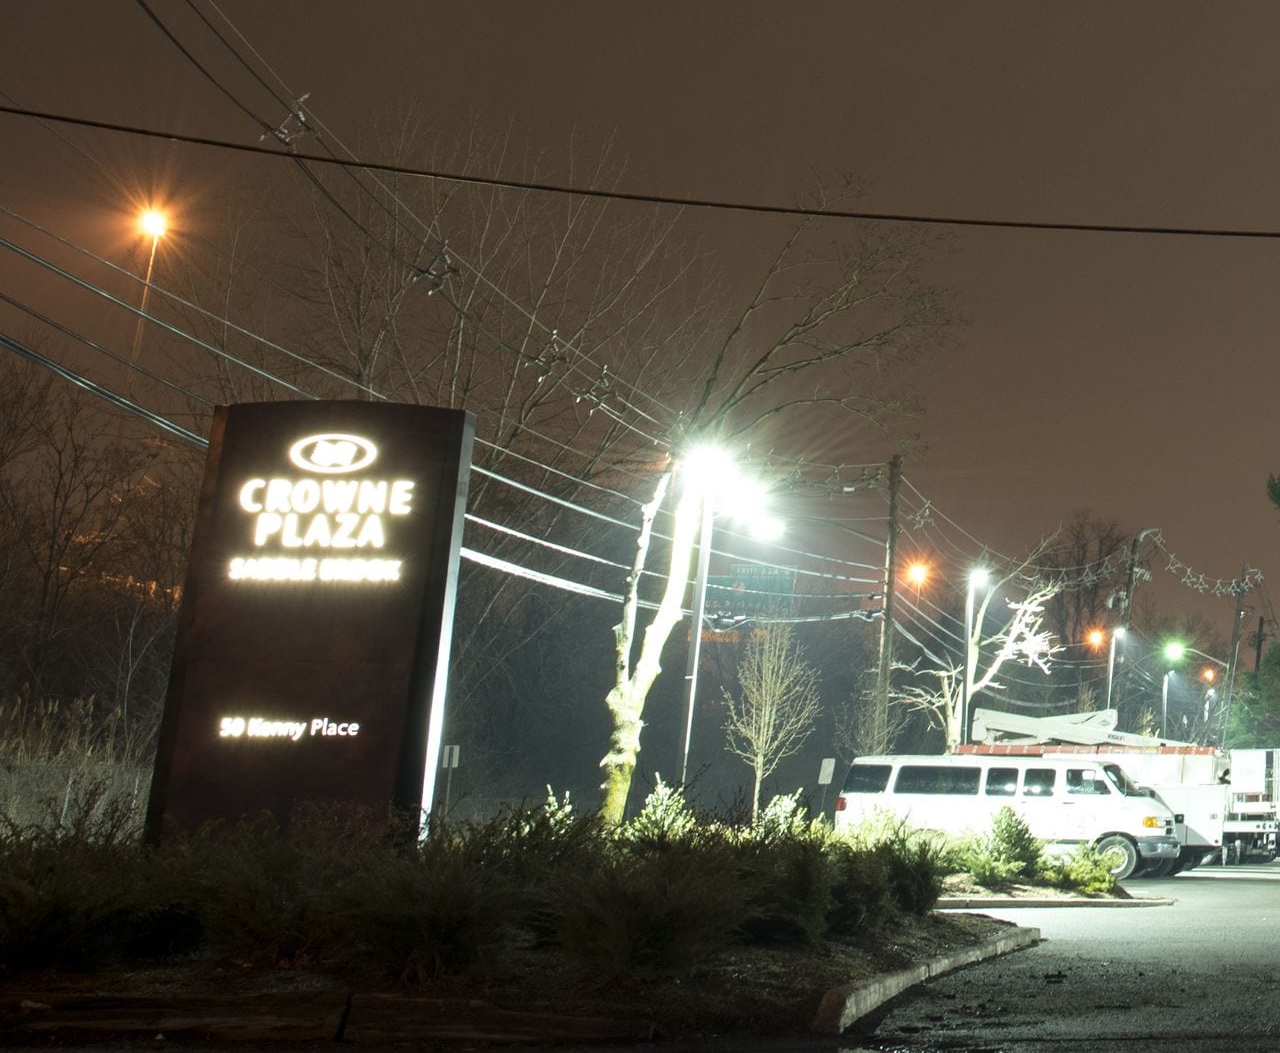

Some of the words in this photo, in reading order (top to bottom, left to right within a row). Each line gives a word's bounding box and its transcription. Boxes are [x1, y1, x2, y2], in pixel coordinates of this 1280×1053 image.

[239, 478, 415, 514] CROWNE
[254, 512, 385, 547] PLAZA
[310, 717, 360, 736] Place
